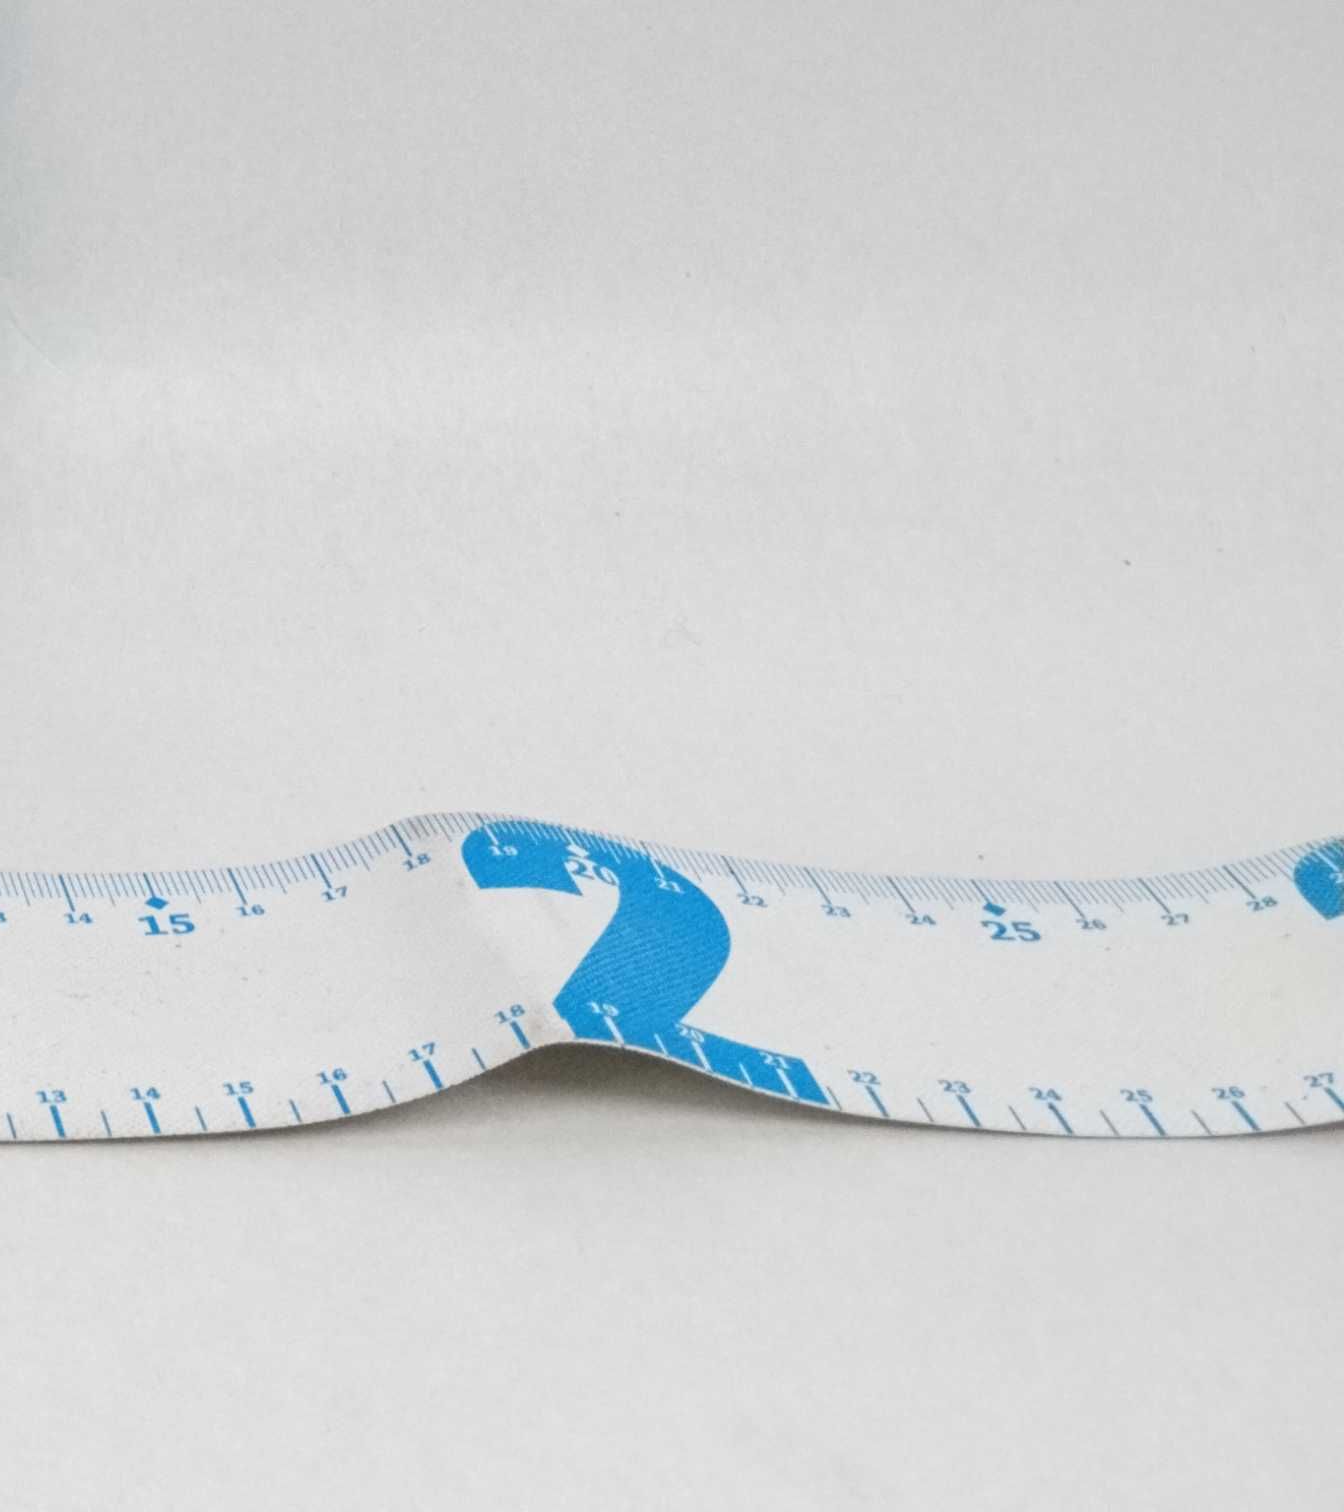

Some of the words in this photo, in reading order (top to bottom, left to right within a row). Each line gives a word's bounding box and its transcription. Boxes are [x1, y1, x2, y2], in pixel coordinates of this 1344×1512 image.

[65, 911, 93, 924] 14
[139, 913, 195, 935] 15
[237, 904, 265, 917] 16
[321, 887, 349, 901] 17
[402, 852, 431, 869] 18
[488, 843, 517, 858] 19
[564, 857, 615, 884] 20
[738, 893, 767, 908] 22
[822, 903, 851, 918] 23
[907, 913, 936, 926] 24
[981, 919, 1041, 942] 25
[1076, 918, 1106, 931] 26
[1161, 913, 1191, 926] 27
[1328, 872, 1344, 884] 2
[461, 820, 830, 1106] 2
[36, 1089, 66, 1104] 13
[130, 1087, 161, 1101] 14
[223, 1081, 254, 1095] 15
[317, 1068, 347, 1084] 16
[408, 1043, 437, 1061] 17
[495, 1005, 525, 1024] 18
[589, 1002, 619, 1019] 19
[848, 1070, 880, 1086] 22
[938, 1079, 972, 1093] 23
[1029, 1087, 1063, 1102] 24
[1120, 1088, 1152, 1103] 25
[1213, 1086, 1247, 1100] 26
[1302, 1072, 1334, 1088] 27
